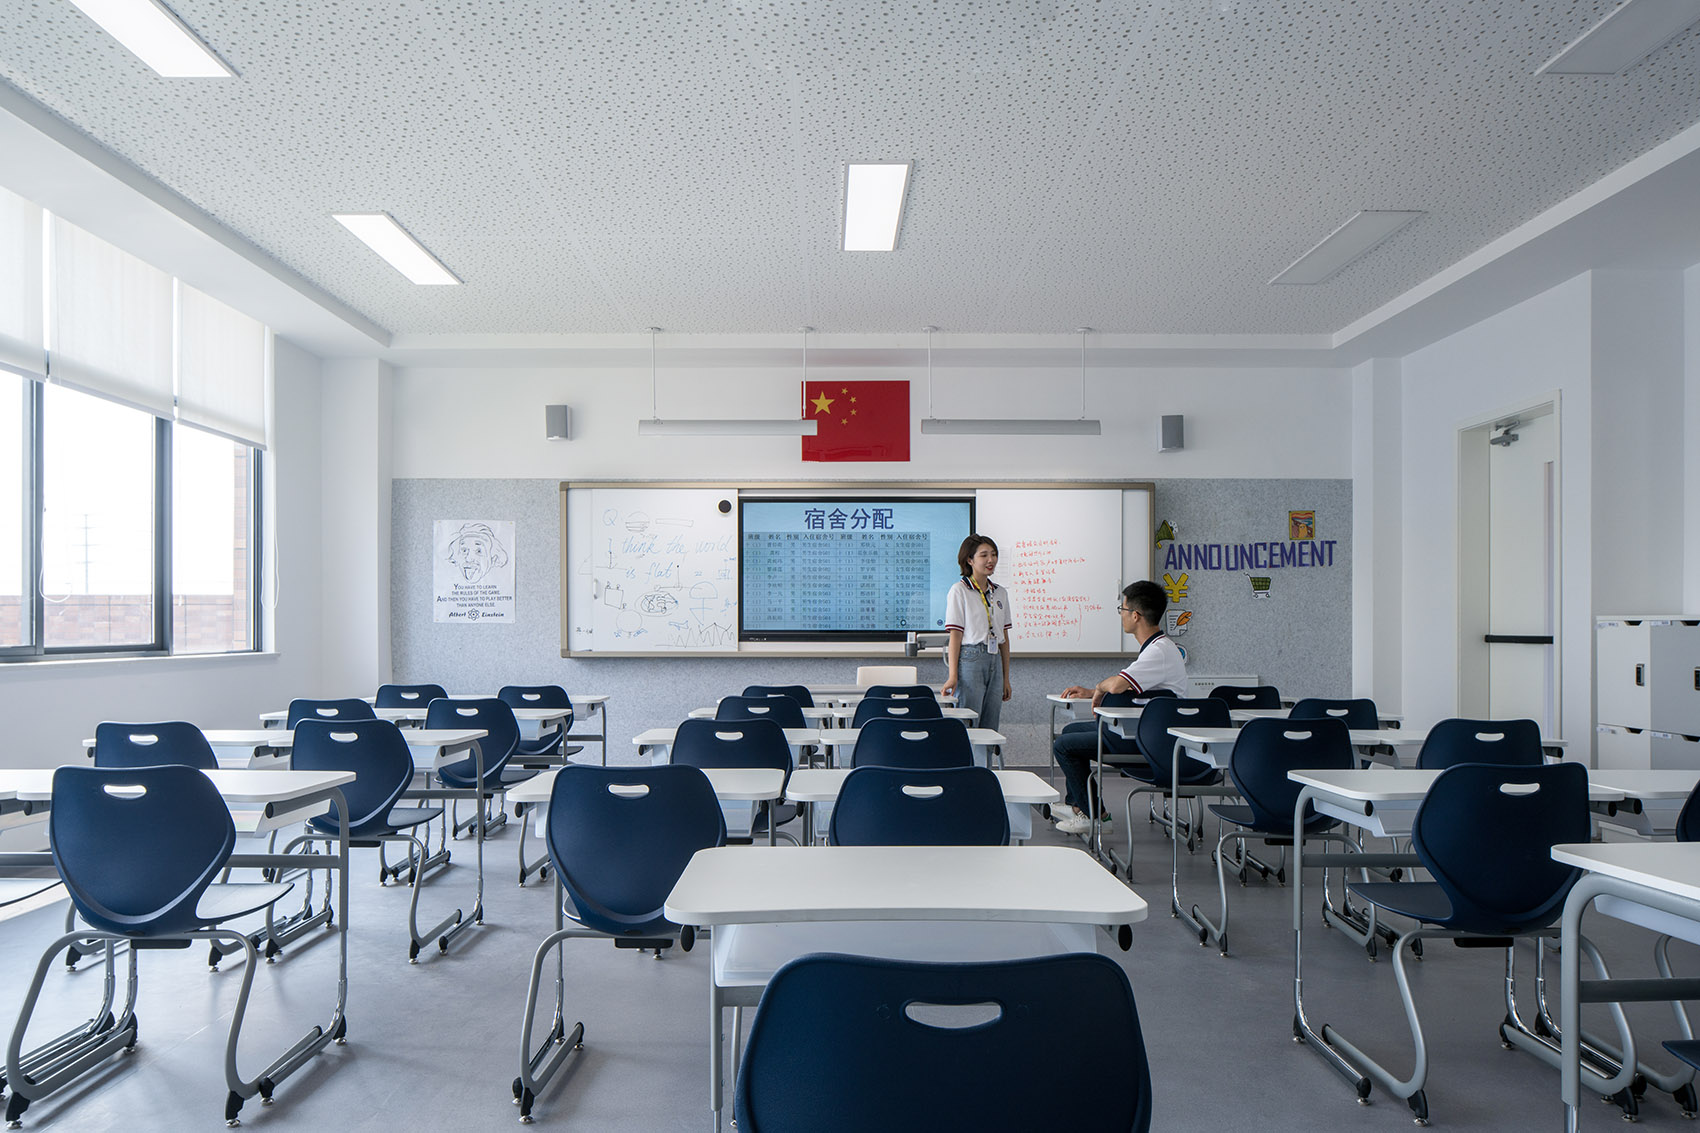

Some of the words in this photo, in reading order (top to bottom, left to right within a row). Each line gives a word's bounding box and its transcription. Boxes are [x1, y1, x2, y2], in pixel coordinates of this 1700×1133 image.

[804, 508, 894, 530] 宿舍分配
[622, 535, 663, 554] think
[666, 534, 688, 554] the
[695, 535, 733, 552] world
[1164, 540, 1337, 571] ANNOUNCEMENT
[625, 568, 636, 580] is
[645, 562, 674, 584] flat
